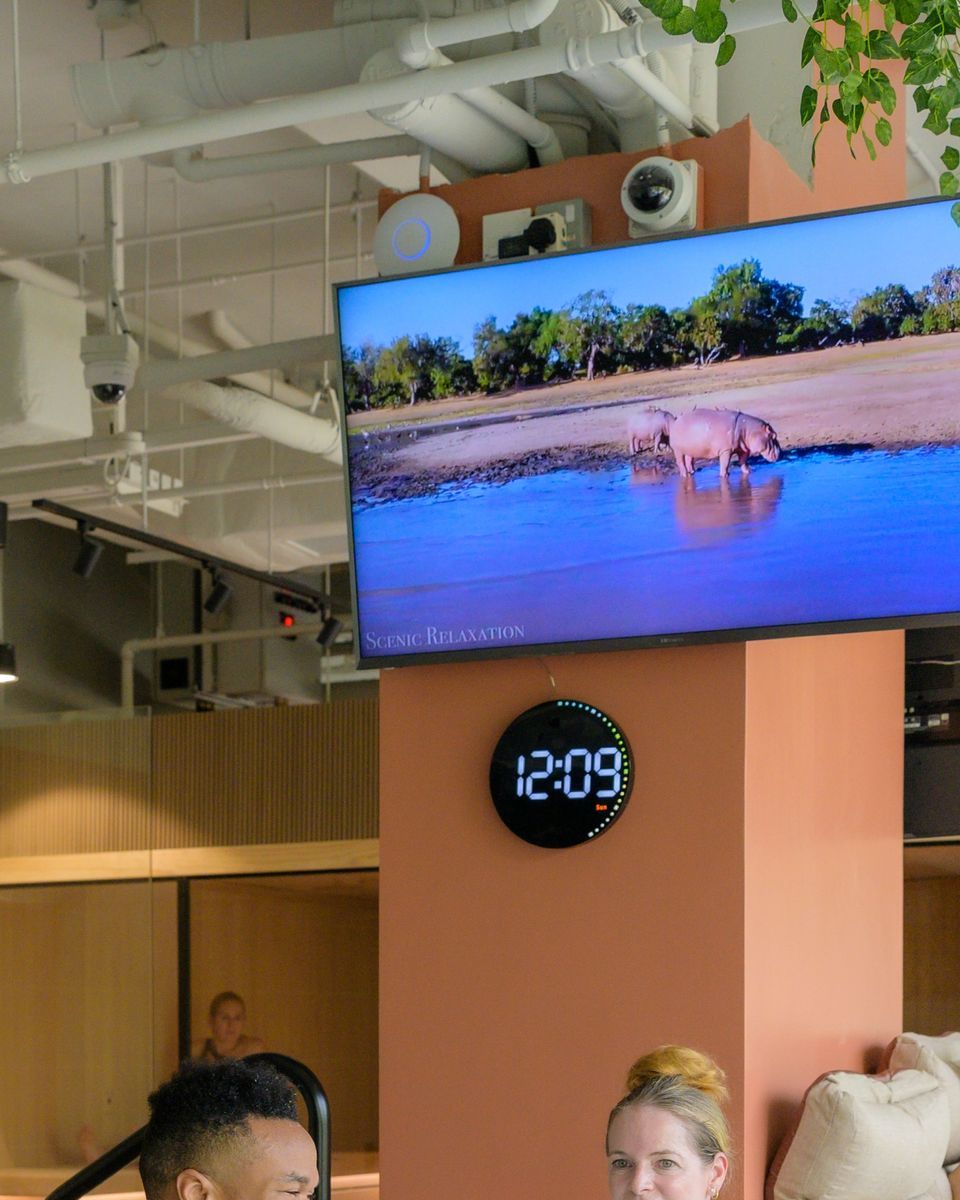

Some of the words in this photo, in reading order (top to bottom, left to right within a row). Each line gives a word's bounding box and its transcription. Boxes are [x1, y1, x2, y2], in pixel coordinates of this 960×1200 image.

[366, 631, 422, 649] SCENIC
[427, 625, 526, 645] RELAXATION
[516, 747, 622, 800] 12:09
